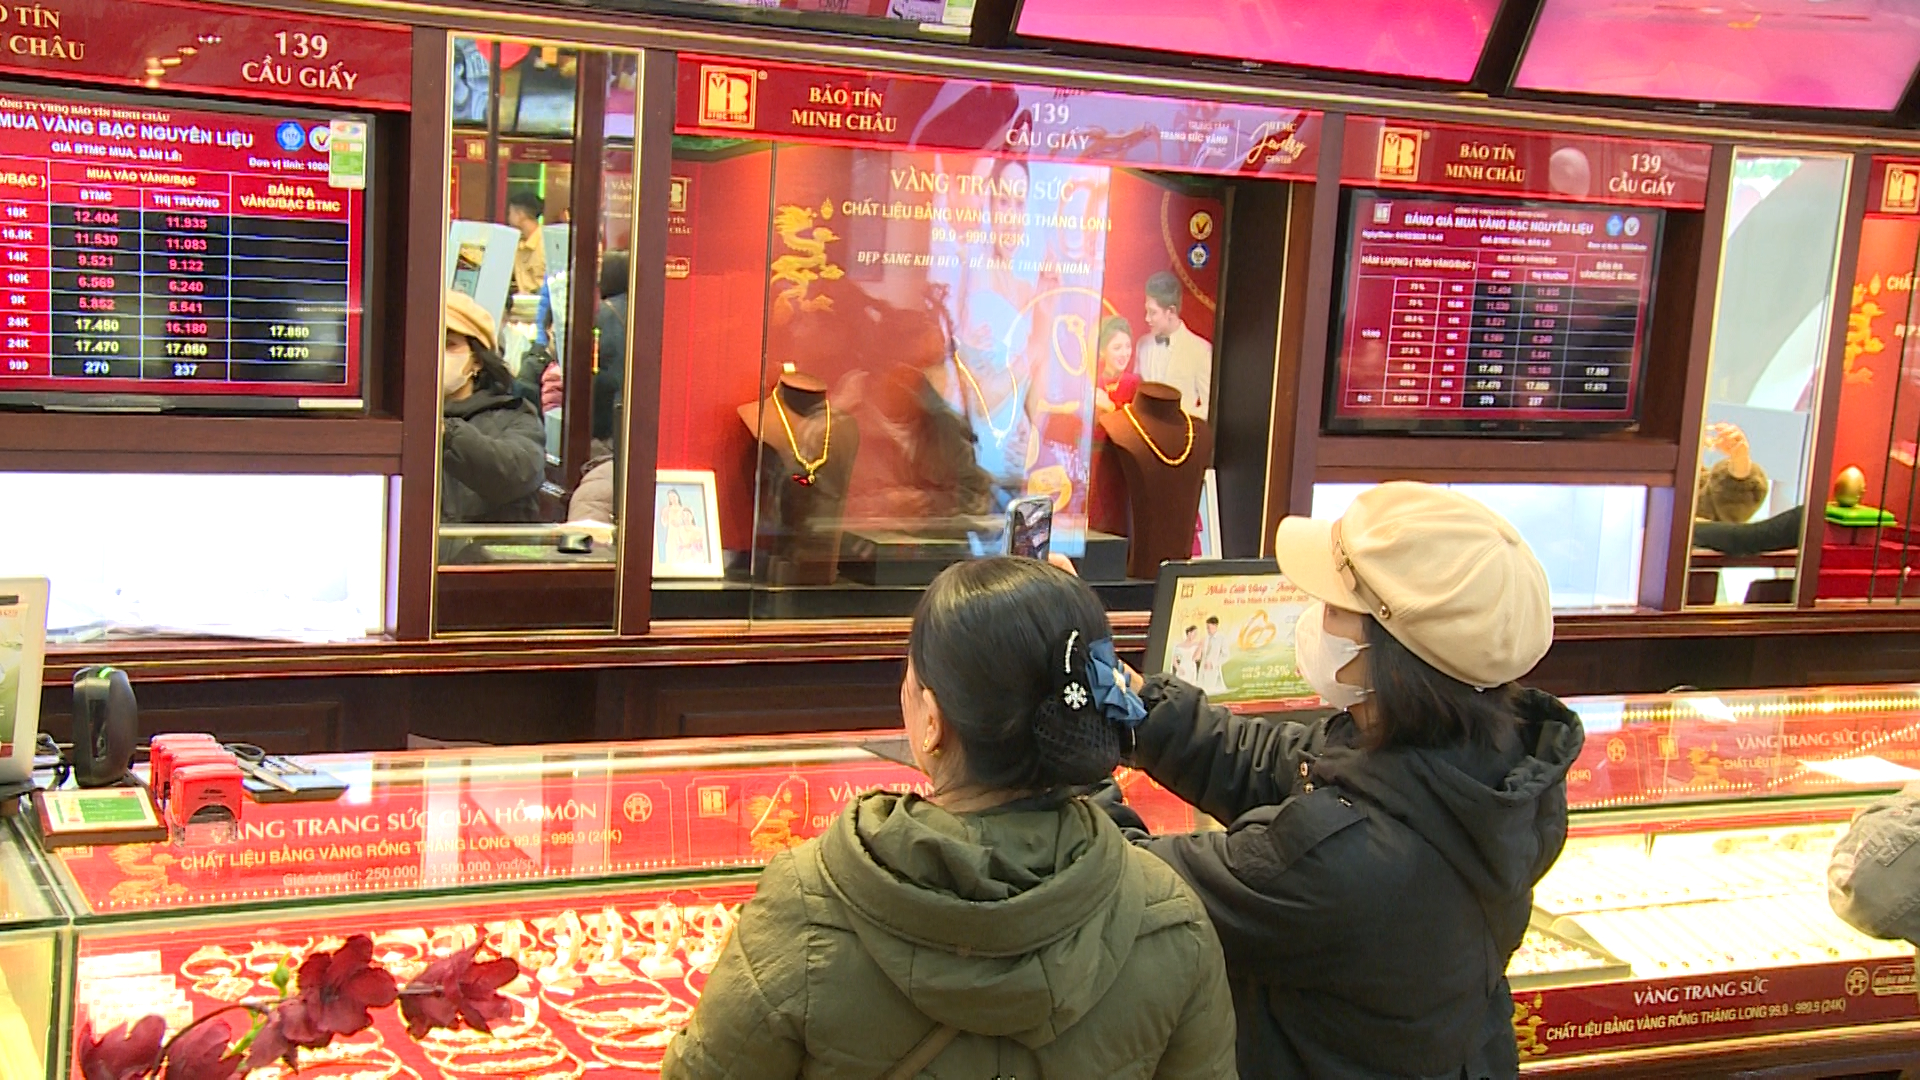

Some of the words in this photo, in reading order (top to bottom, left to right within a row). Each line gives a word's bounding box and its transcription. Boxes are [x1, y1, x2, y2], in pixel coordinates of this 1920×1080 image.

[16, 4, 60, 28] TÍN
[9, 34, 84, 61] CHÂU
[275, 31, 328, 58] 139
[242, 55, 291, 85] CẦU
[299, 62, 358, 90] GIẤY
[809, 84, 848, 105] BẢO
[852, 87, 882, 108] TÍN
[792, 109, 842, 129] MINH
[846, 112, 897, 133] CHÂU
[1032, 102, 1070, 124] 139
[0, 113, 38, 131] MUA
[42, 115, 94, 135] VÀNG
[98, 121, 136, 139] BẠC
[140, 124, 212, 144] NGUYÊN
[216, 128, 253, 149] LIỆU
[1006, 122, 1042, 147] CẦU
[1047, 127, 1090, 150] GIẤY
[1459, 141, 1489, 160] BẢO
[1492, 144, 1515, 160] TÍN
[1630, 153, 1661, 173] 139
[86, 169, 112, 180] MUA
[1446, 164, 1483, 181] MINH
[1486, 166, 1526, 183] CHÂU
[297, 186, 314, 198] RA
[890, 166, 949, 195] VÀNG
[957, 175, 1028, 199] TRANG
[1033, 177, 1074, 202] SỨC
[1609, 172, 1638, 193] CẦU
[1641, 177, 1675, 196] GIẤY
[80, 189, 112, 201] BTMC
[153, 194, 171, 208] THỊ
[306, 199, 341, 211] BTMC
[842, 198, 879, 216] CHẤT
[882, 202, 912, 220] LIỆU
[914, 202, 952, 222] BẰNG
[955, 206, 991, 224] VÀNG
[73, 210, 119, 225] 12.404
[166, 215, 207, 229] 11.935
[74, 232, 118, 246] 11.530
[166, 238, 207, 250] 11.083
[7, 251, 28, 262] 14K
[882, 252, 912, 266] SANG
[914, 254, 933, 266] KHI
[75, 340, 120, 353] 17.470
[84, 362, 110, 374] 270
[174, 364, 198, 376] 237
[1736, 734, 1778, 751] VÀNG
[1782, 732, 1829, 748] TRANG
[292, 815, 379, 837] TRANG
[388, 808, 432, 831] SỨC
[438, 803, 488, 828] CỦA
[543, 799, 597, 821] MÔN
[181, 850, 226, 871] CHẤT
[230, 850, 265, 868] LIỆU
[269, 844, 314, 864] BẰNG
[319, 842, 362, 860] VÀNG
[470, 836, 511, 851] LONG
[365, 865, 418, 881] 250.000
[1633, 985, 1680, 1006] VÀNG
[1682, 981, 1736, 1002] TRANG
[1740, 976, 1769, 996] SỨC
[1545, 1023, 1577, 1041] CHẤT
[1578, 1021, 1603, 1040] LIỆU
[1603, 1017, 1635, 1035] BẰNG
[1636, 1013, 1666, 1031] VÀNG
[1700, 1006, 1737, 1024] THĂNG
[1738, 1004, 1768, 1021] LONG
